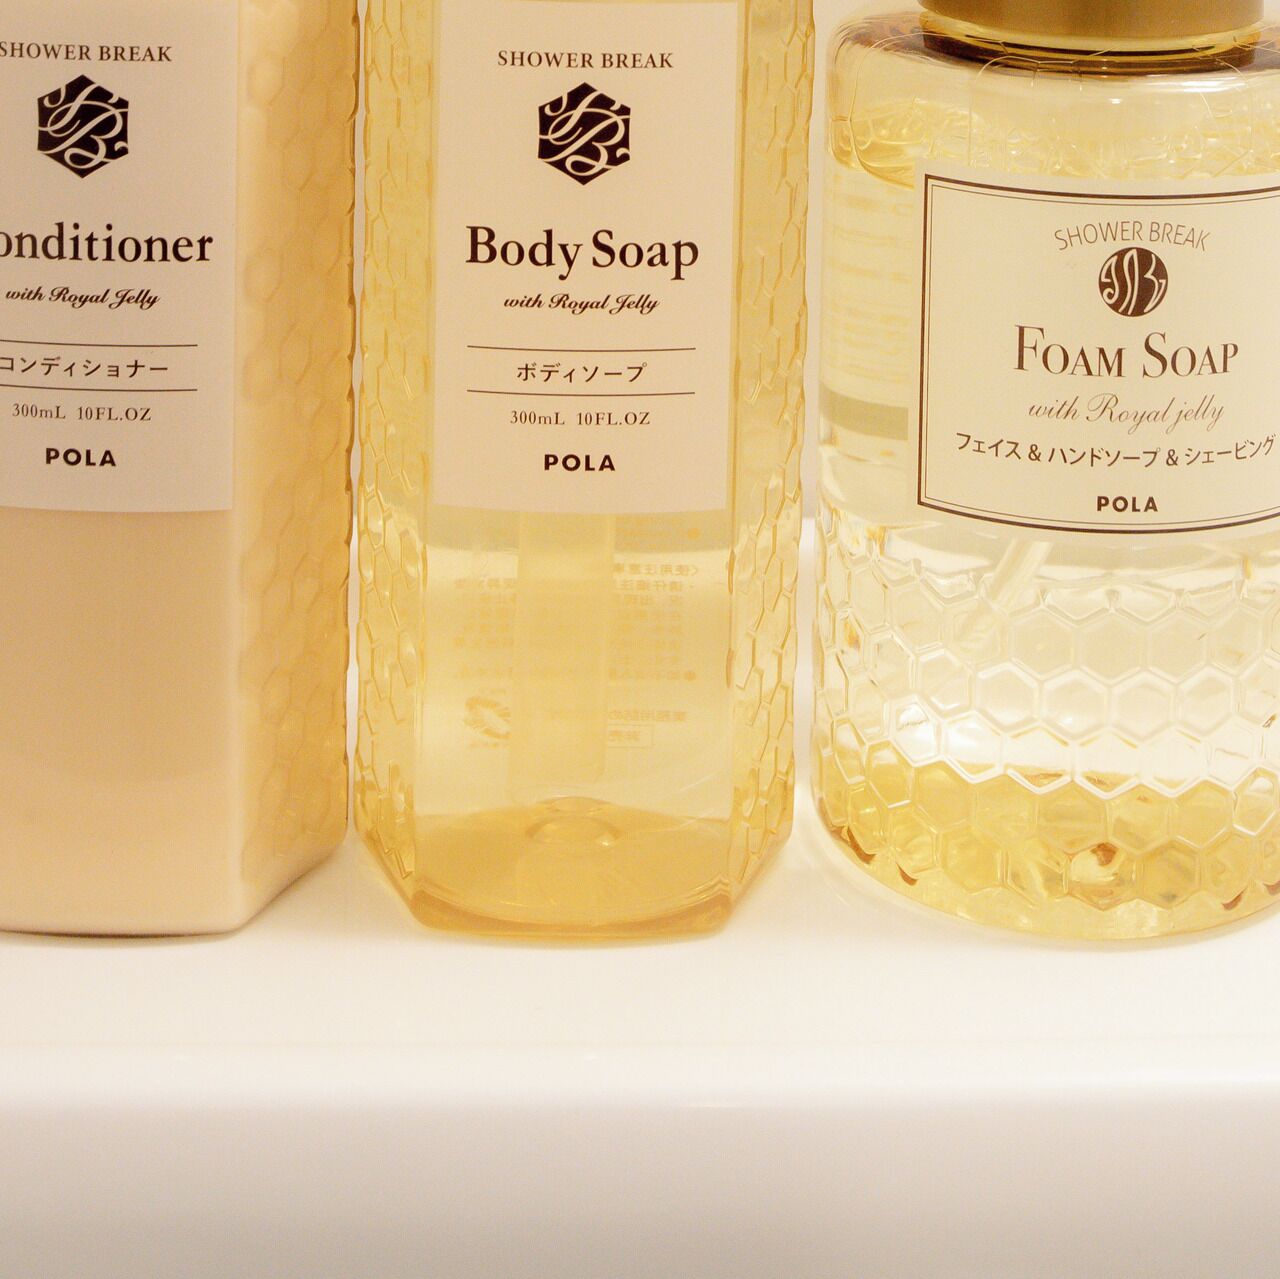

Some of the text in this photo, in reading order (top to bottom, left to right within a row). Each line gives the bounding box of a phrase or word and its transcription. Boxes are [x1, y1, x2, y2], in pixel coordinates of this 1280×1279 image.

[0, 41, 171, 61] SHOWER BREAK
[498, 51, 672, 68] SHOWER BREAK
[1055, 220, 1210, 252] SHOWER BREAK
[466, 226, 698, 280] Body Soap
[6, 286, 159, 310] with Royal Jelly
[504, 294, 659, 314] with Royal Jelly
[0, 357, 167, 378] コンディショナー
[517, 363, 647, 383] ボディソープ
[13, 404, 151, 420] 300mL 10FL.OZ
[511, 411, 649, 425] 300mL 10FL.OZ
[1029, 394, 1223, 434] with Royal jelly
[46, 448, 116, 466] POLA
[957, 433, 1276, 467] フェイス & ハンドソープ & シェービング
[545, 454, 615, 471] POLA
[1097, 496, 1158, 512] POLA
